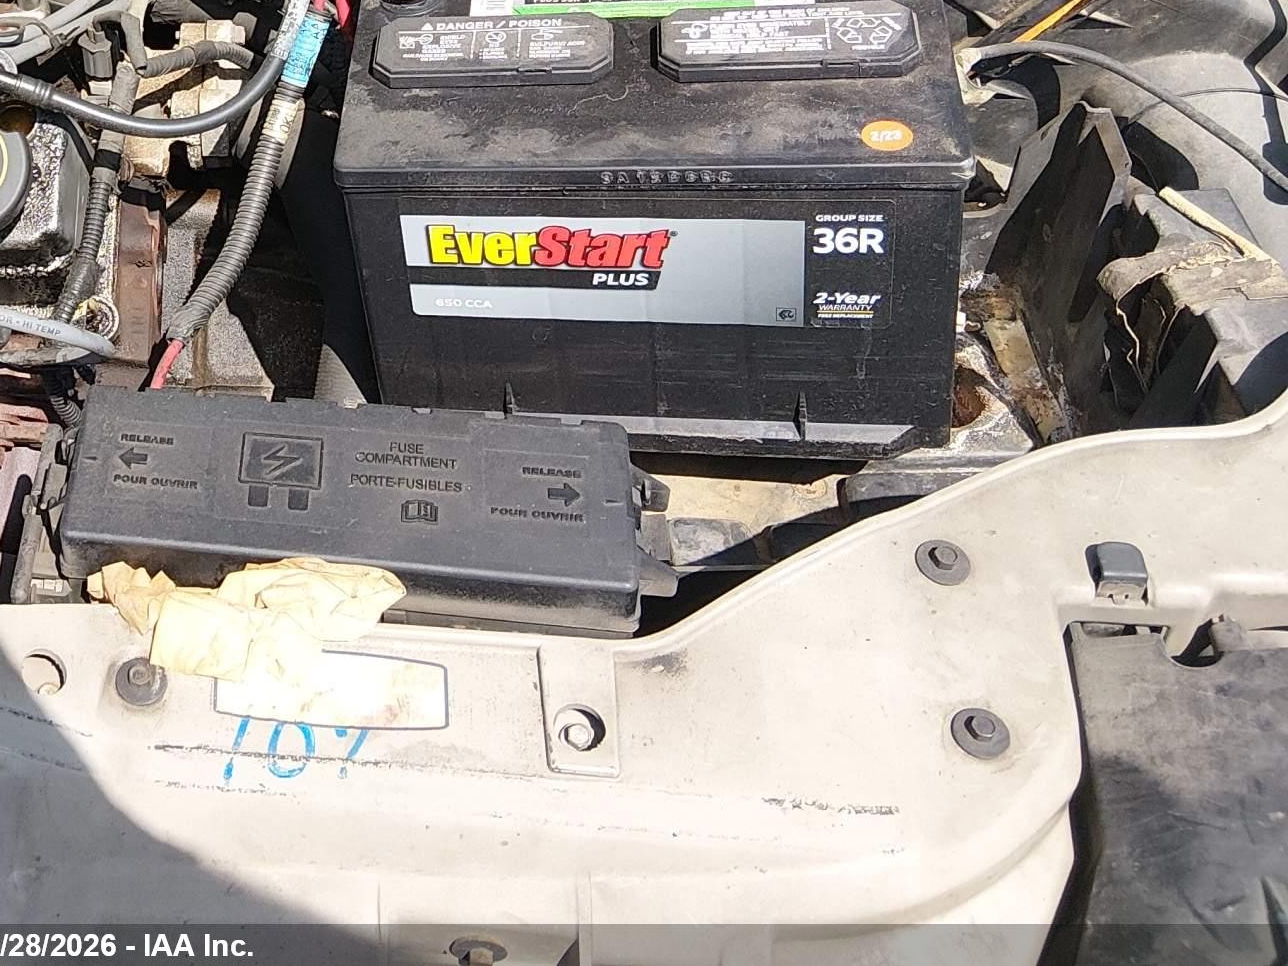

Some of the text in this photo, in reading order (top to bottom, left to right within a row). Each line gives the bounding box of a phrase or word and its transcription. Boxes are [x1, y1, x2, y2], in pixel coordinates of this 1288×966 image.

[436, 20, 494, 30] DANGER
[508, 18, 562, 28] POISON
[815, 214, 885, 222] GROUP SIZE
[425, 223, 671, 270] EverStart
[812, 227, 885, 254] 36R
[592, 273, 650, 286] PLUS
[434, 297, 493, 309] 650 CCA
[812, 291, 882, 305] 2-Year
[34, 322, 62, 337] TEMP
[120, 433, 174, 446] RELEASE
[389, 441, 424, 455] FUSE
[354, 452, 458, 470] COMPARTMENT
[522, 466, 583, 479] RELEASE
[113, 473, 198, 490] POUR OUVRIR
[350, 473, 463, 493] PORTE-FUSIBLES
[490, 506, 585, 522] POUR OUVRIR
